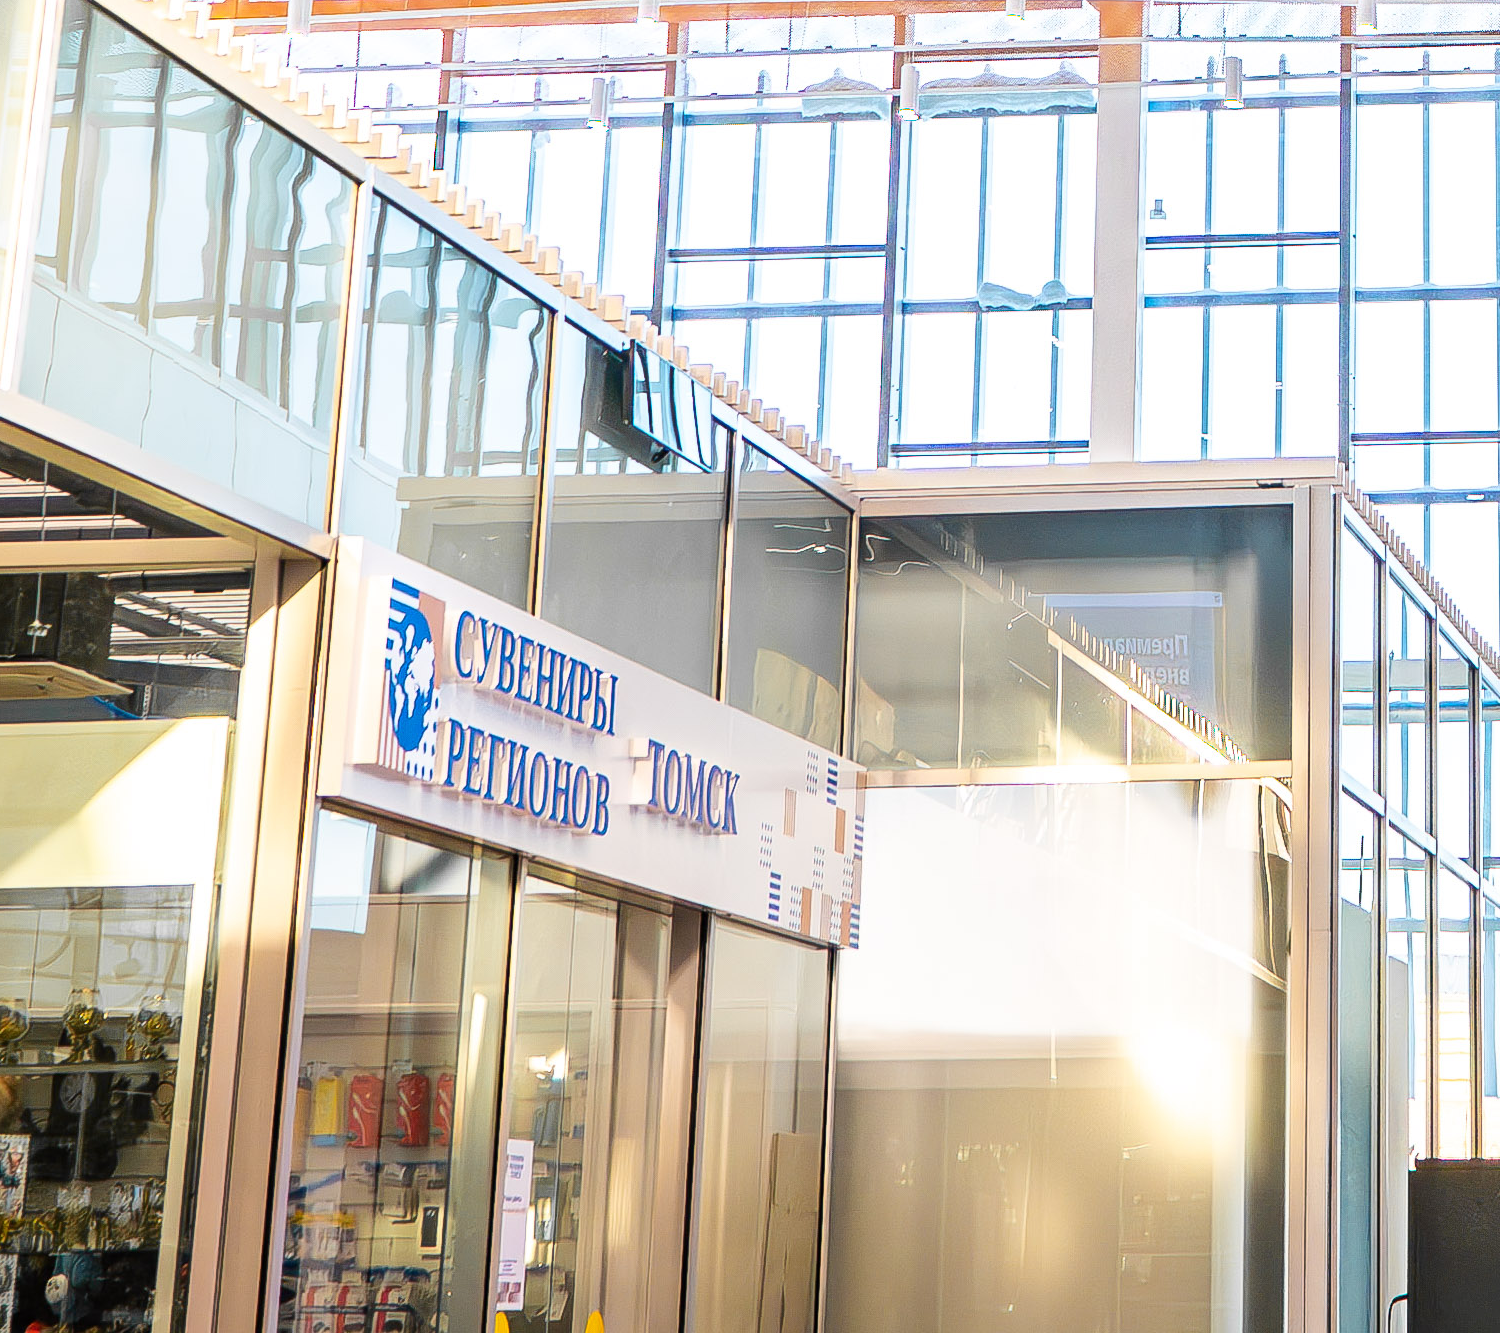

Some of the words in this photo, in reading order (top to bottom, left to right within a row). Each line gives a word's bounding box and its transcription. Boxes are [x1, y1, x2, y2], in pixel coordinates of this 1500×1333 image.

[455, 610, 619, 736] СУВЕНИРЫ
[443, 717, 610, 836] РЕГИОНОВ
[648, 738, 740, 835] ТОМСК
